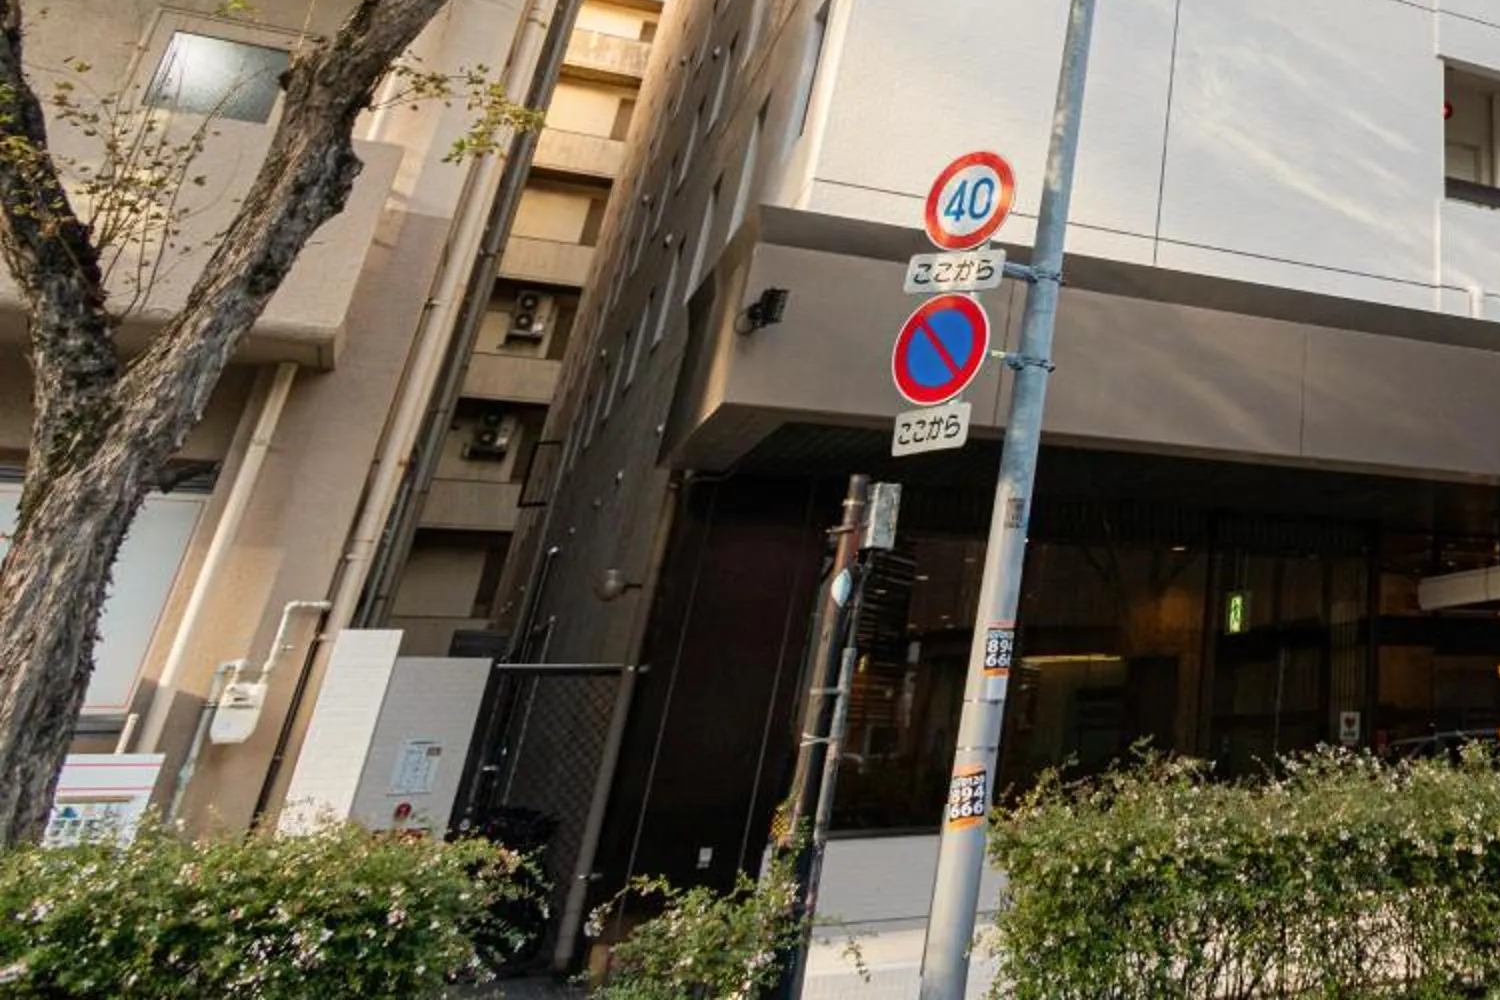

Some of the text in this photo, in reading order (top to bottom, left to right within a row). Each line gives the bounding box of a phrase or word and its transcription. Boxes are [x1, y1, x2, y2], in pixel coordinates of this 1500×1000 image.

[943, 177, 995, 223] 40
[912, 259, 995, 285] ここから
[898, 415, 961, 445] ここから
[950, 799, 984, 819] 666
